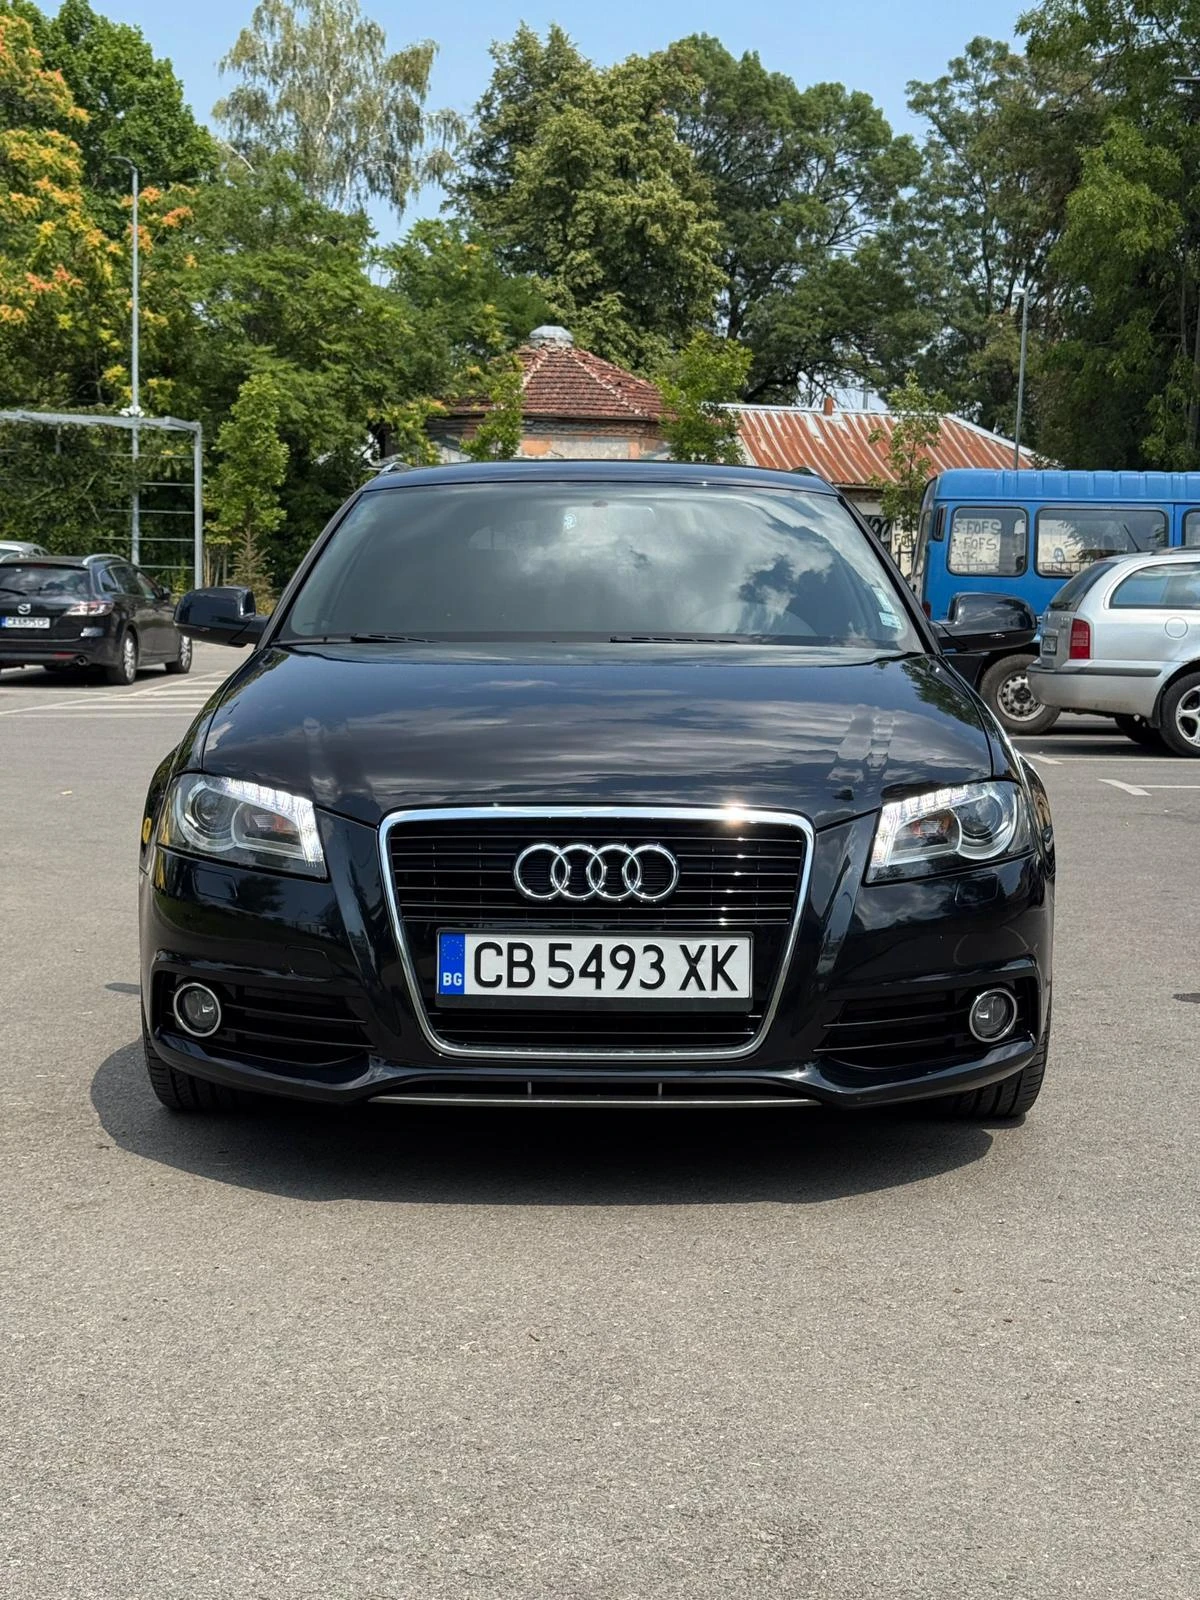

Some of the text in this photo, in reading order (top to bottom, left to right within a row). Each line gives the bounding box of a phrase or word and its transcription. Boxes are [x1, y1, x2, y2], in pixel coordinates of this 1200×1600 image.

[443, 972, 462, 987] BG
[473, 941, 738, 992] CB 5493 XK
